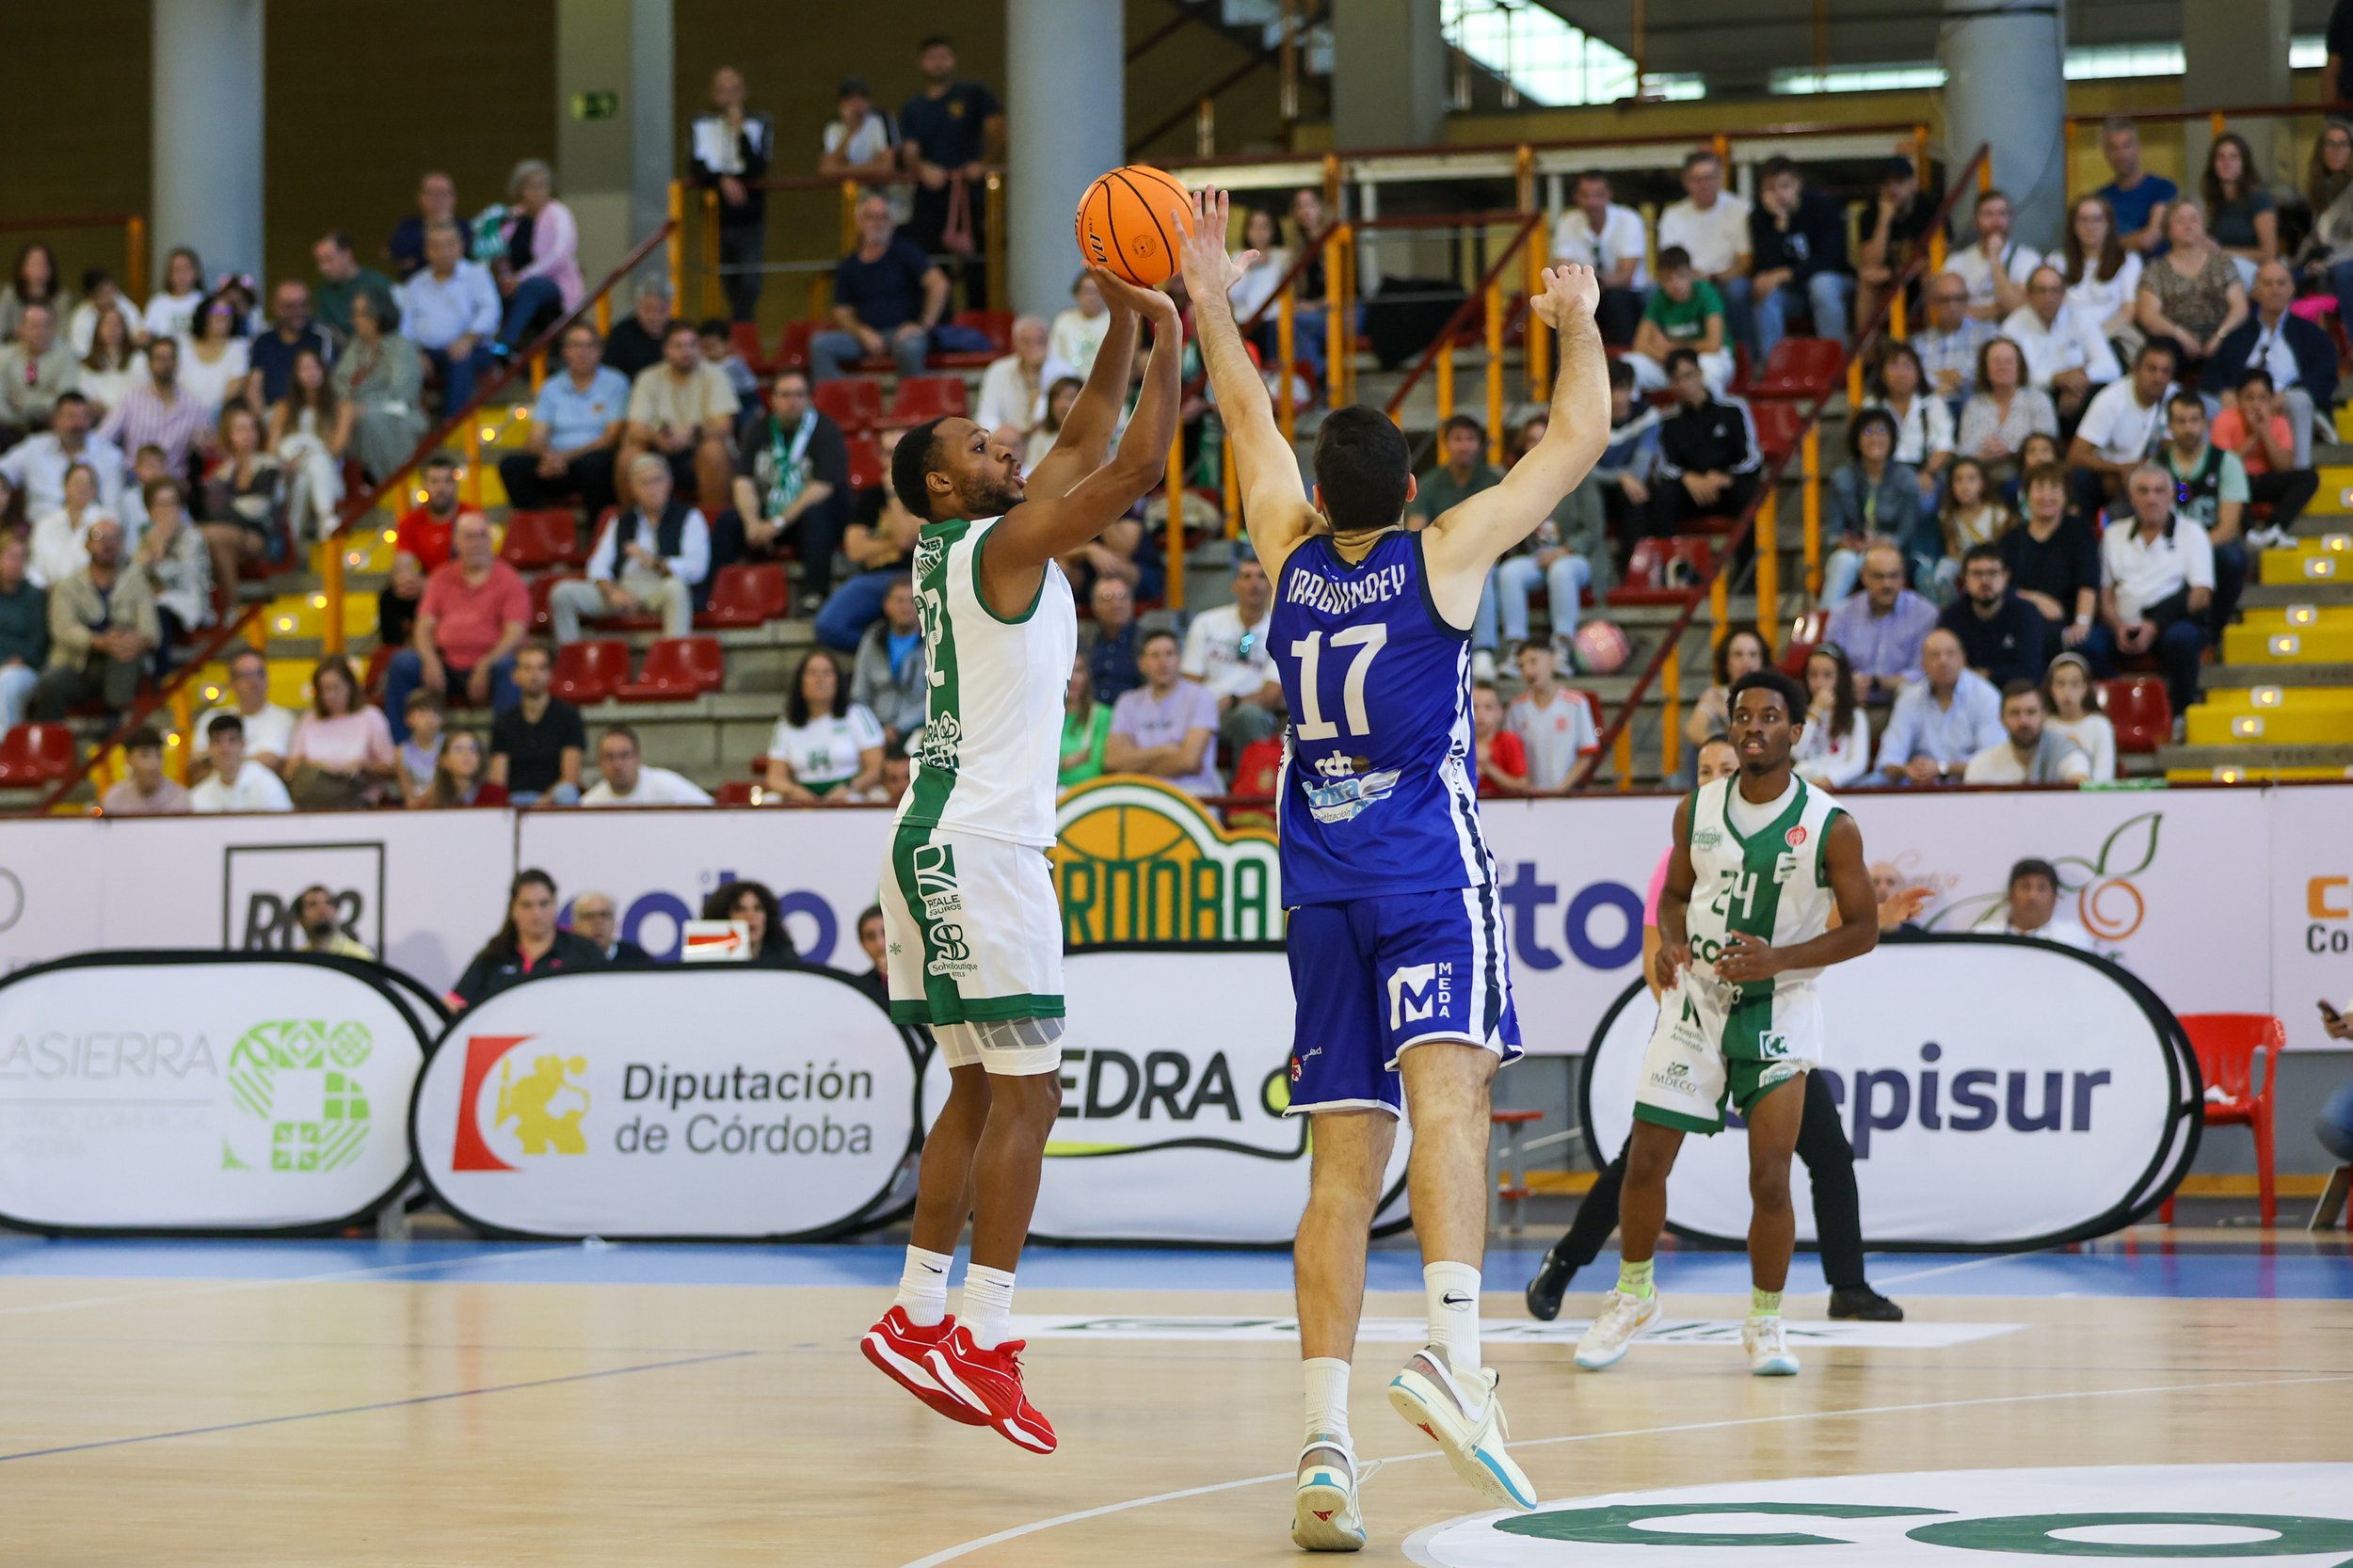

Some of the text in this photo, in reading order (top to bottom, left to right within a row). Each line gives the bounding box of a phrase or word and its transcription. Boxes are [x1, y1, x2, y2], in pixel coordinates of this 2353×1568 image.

[1290, 622, 1388, 742] 17
[1500, 862, 1645, 970] to
[1711, 869, 1758, 920] 24
[2306, 922, 2353, 954] Co
[1438, 962, 1452, 1018] MEDA
[622, 1060, 872, 1111] Diputación
[1060, 1049, 1241, 1121] EDRA
[1726, 1042, 2110, 1160] pisur
[616, 1113, 872, 1155] de Córdoba
